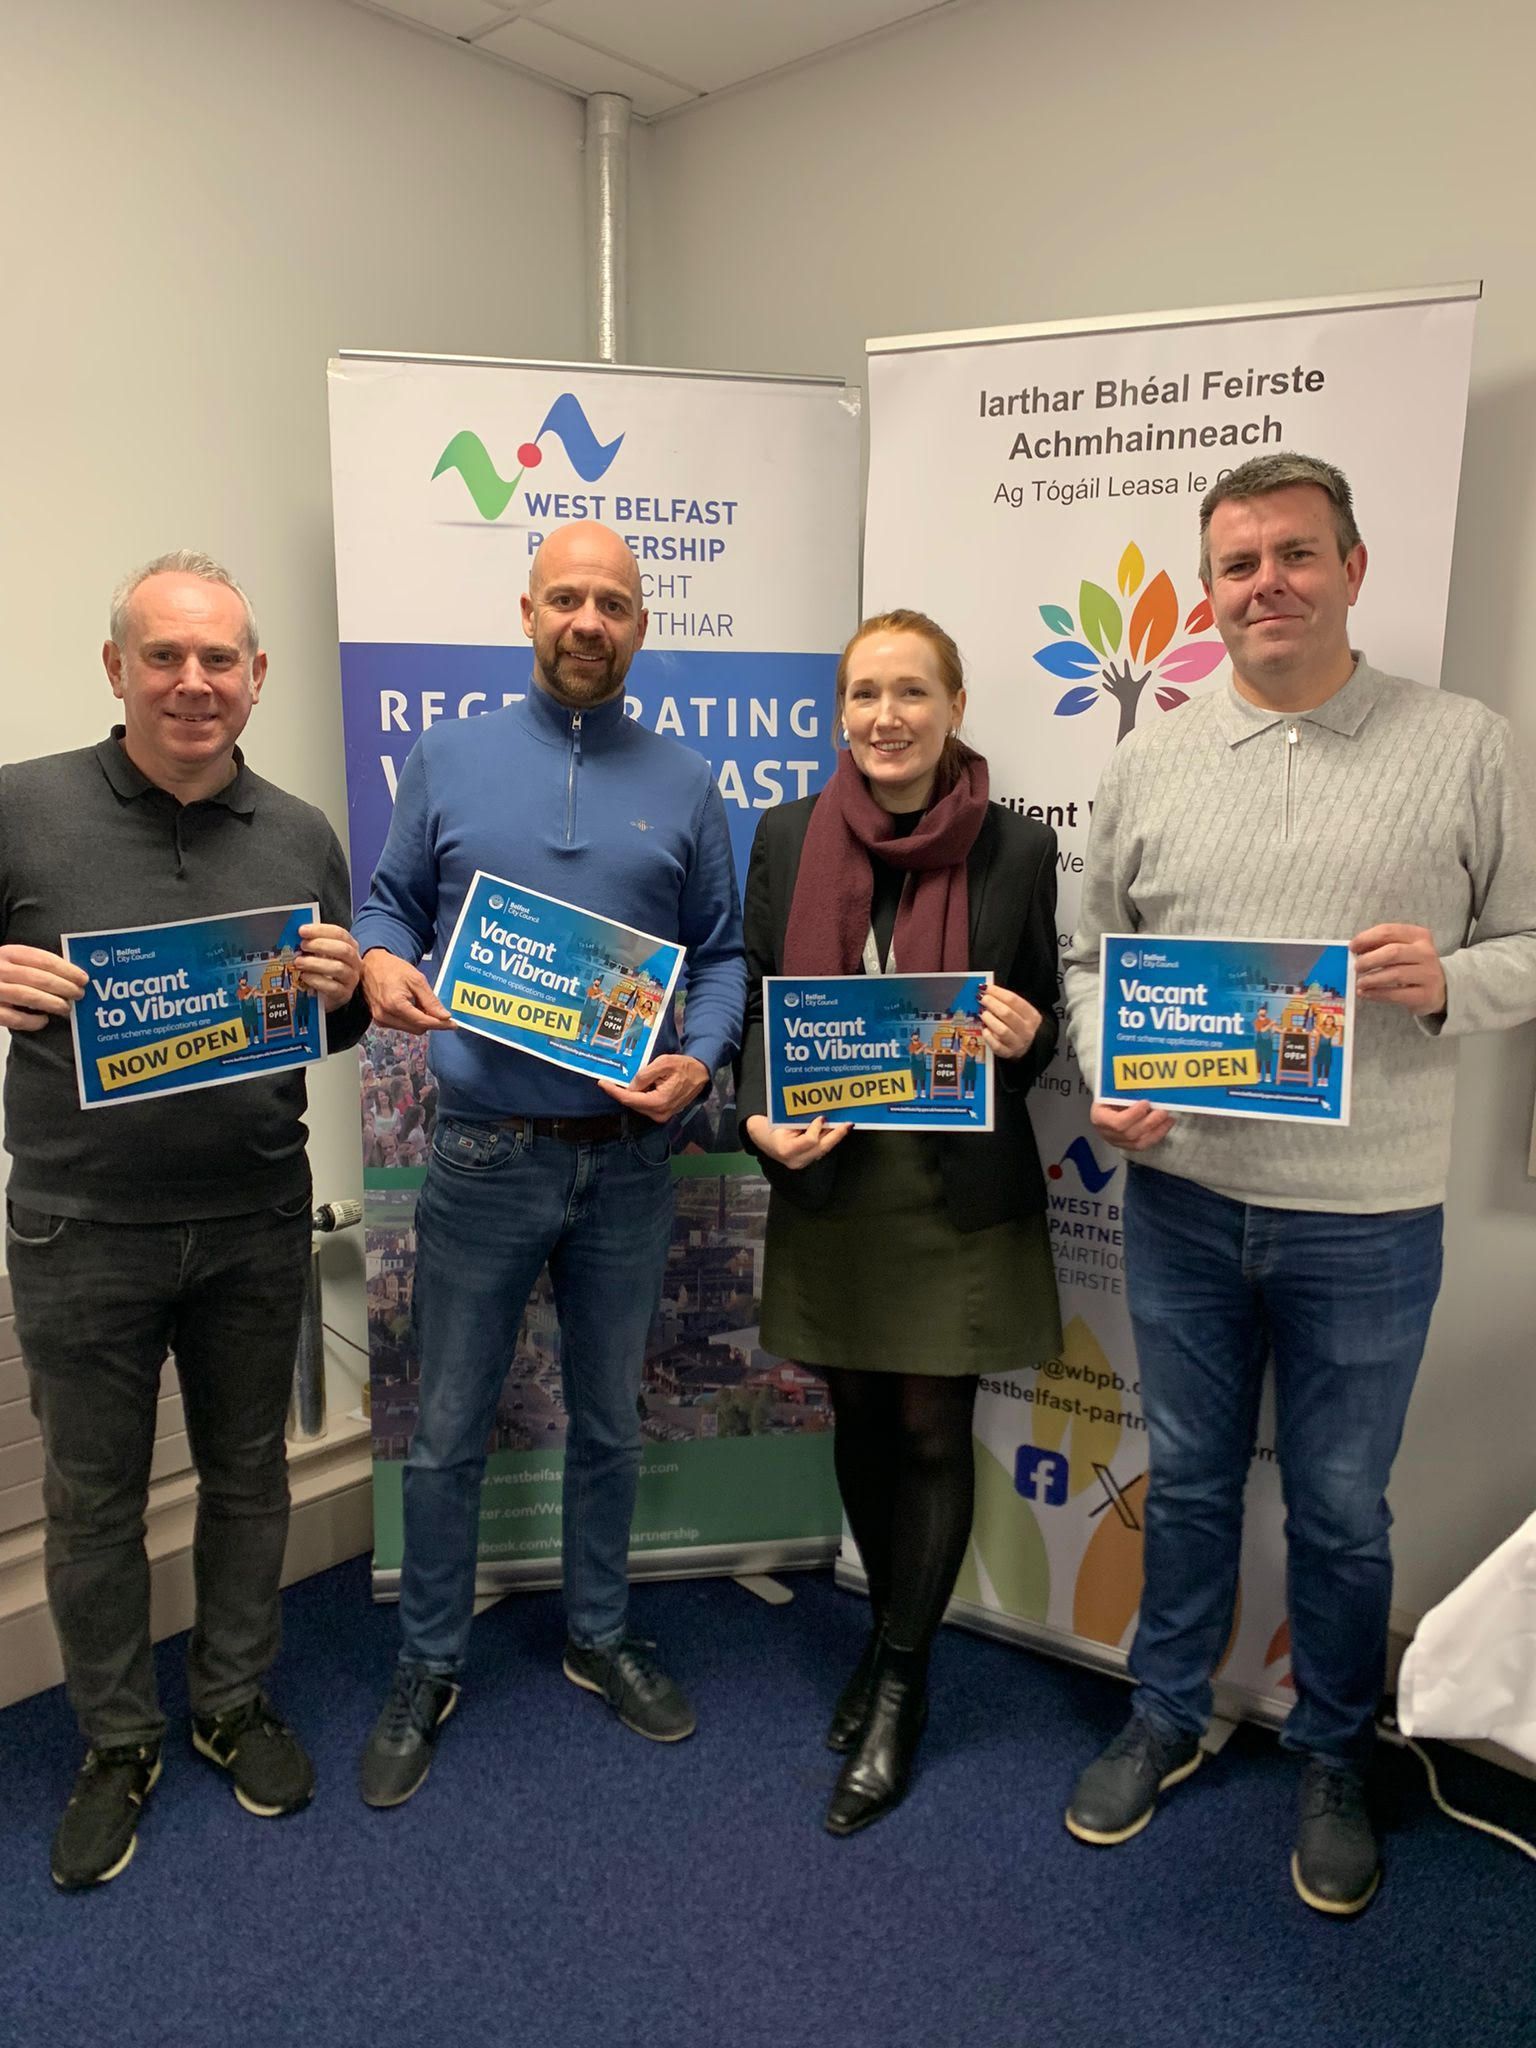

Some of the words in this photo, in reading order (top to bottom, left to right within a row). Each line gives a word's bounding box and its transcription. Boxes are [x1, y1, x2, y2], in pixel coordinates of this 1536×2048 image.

[979, 384, 1084, 418] Iarthar
[1095, 374, 1190, 410] Bhéal
[1202, 364, 1326, 401] Feirste
[1009, 415, 1284, 461] Achmhainneach
[994, 483, 1024, 508] Ag
[1031, 477, 1100, 506] Tógáil
[1108, 476, 1179, 497] Leasa
[1187, 472, 1208, 493] le
[525, 492, 606, 520] WEST
[615, 497, 738, 526] BELFAST
[528, 531, 726, 562] PERSHIP
[653, 611, 733, 637] THIAR
[507, 907, 521, 918] City
[518, 912, 540, 924] Council
[509, 902, 531, 914] Belfast
[116, 947, 141, 957] Belfast
[480, 916, 557, 964] Vacant
[116, 955, 131, 964] City
[131, 951, 156, 962] Council
[470, 940, 494, 965] to
[499, 948, 581, 997] Vibrant
[1157, 961, 1179, 969] Council
[92, 968, 190, 1002] Vacant
[463, 961, 482, 975] Grant
[482, 970, 507, 985] scheme
[507, 981, 545, 999] applications
[545, 994, 556, 1003] are
[1119, 978, 1208, 1006] Vacant
[95, 1006, 126, 1029] to
[130, 987, 229, 1023] Vibrant
[460, 988, 514, 1016] NOW
[517, 1003, 573, 1032] OPEN
[805, 993, 826, 1001] Belfast
[817, 998, 839, 1006] Council
[268, 1009, 288, 1019] OPEN
[604, 1021, 622, 1031] OPEN
[1118, 1006, 1145, 1028] to
[1149, 1006, 1245, 1035] Vibrant
[97, 1031, 119, 1043] Grant
[120, 1027, 152, 1039] scheme
[153, 1021, 198, 1036] applications
[198, 1017, 212, 1027] are
[783, 1017, 866, 1039] Vacant
[108, 1046, 169, 1080] NOW
[175, 1026, 239, 1059] OPEN
[784, 1041, 810, 1061] to
[814, 1039, 901, 1060] Vibrant
[784, 1065, 803, 1074] Grant
[804, 1065, 830, 1073] scheme
[831, 1063, 871, 1073] applications
[1122, 1060, 1178, 1082] NOW
[1185, 1056, 1248, 1078] OPEN
[791, 1083, 843, 1108] NOW
[850, 1076, 906, 1099] OPEN
[1050, 1194, 1102, 1217] WEST
[1055, 1266, 1121, 1295] EIRSTE
[630, 1527, 700, 1542] artnership
